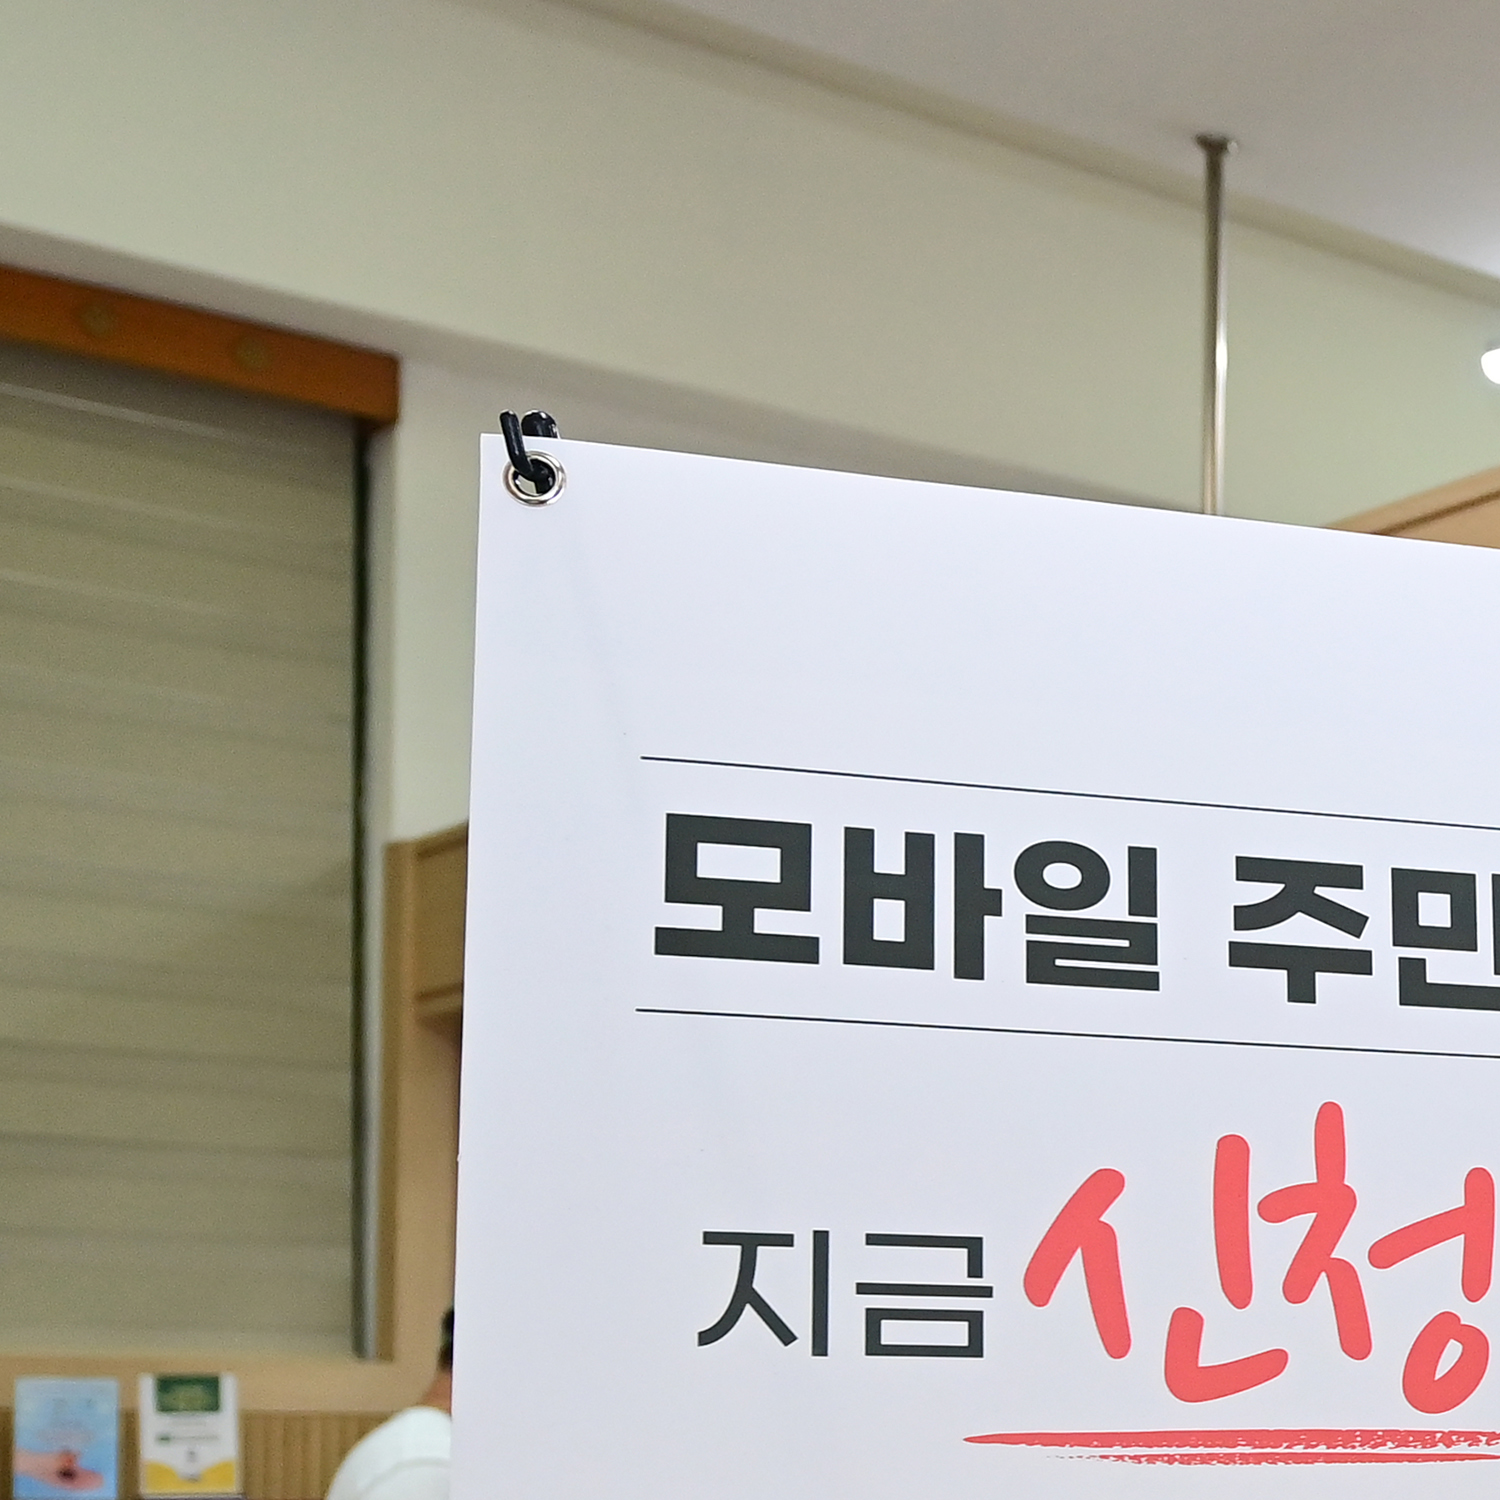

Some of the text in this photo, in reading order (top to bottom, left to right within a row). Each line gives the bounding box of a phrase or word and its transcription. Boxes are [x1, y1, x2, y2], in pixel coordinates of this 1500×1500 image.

[653, 814, 1162, 993] 모바일
[695, 1229, 994, 1360] 지금
[1022, 1100, 1498, 1415] 신청
